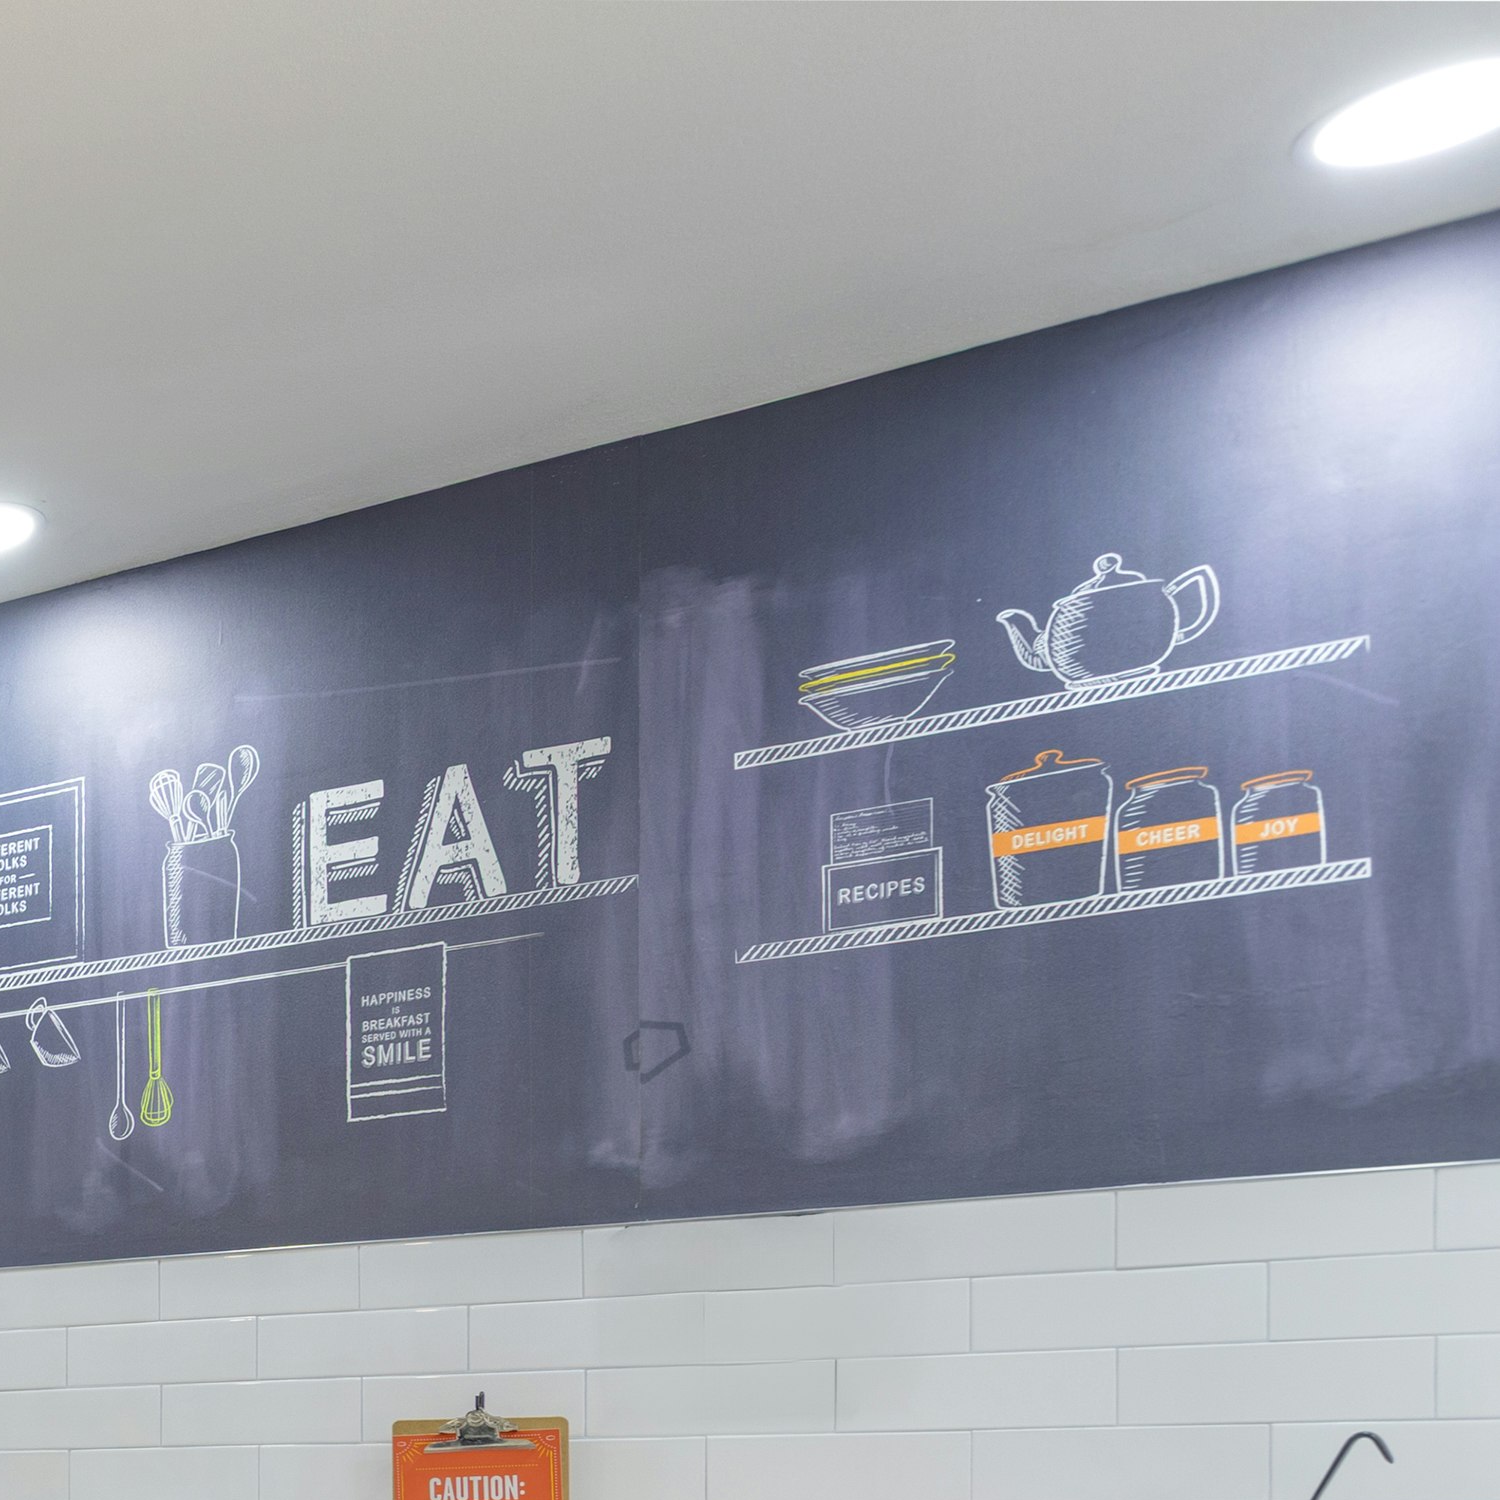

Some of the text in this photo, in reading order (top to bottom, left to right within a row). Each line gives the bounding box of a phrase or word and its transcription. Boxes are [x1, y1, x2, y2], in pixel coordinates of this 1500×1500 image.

[295, 736, 611, 928] EAT
[1012, 824, 1089, 850] DELIGHT
[1135, 826, 1200, 847] CHEER
[1260, 818, 1299, 838] JOY
[0, 874, 17, 886] FOR
[837, 876, 925, 906] RECIPES
[361, 987, 431, 1007] HAPPINESS
[392, 1006, 400, 1014] IS
[362, 1012, 431, 1032] BREAKFAST
[361, 1027, 431, 1043] SERVED WITH A
[361, 1038, 432, 1068] SMILE
